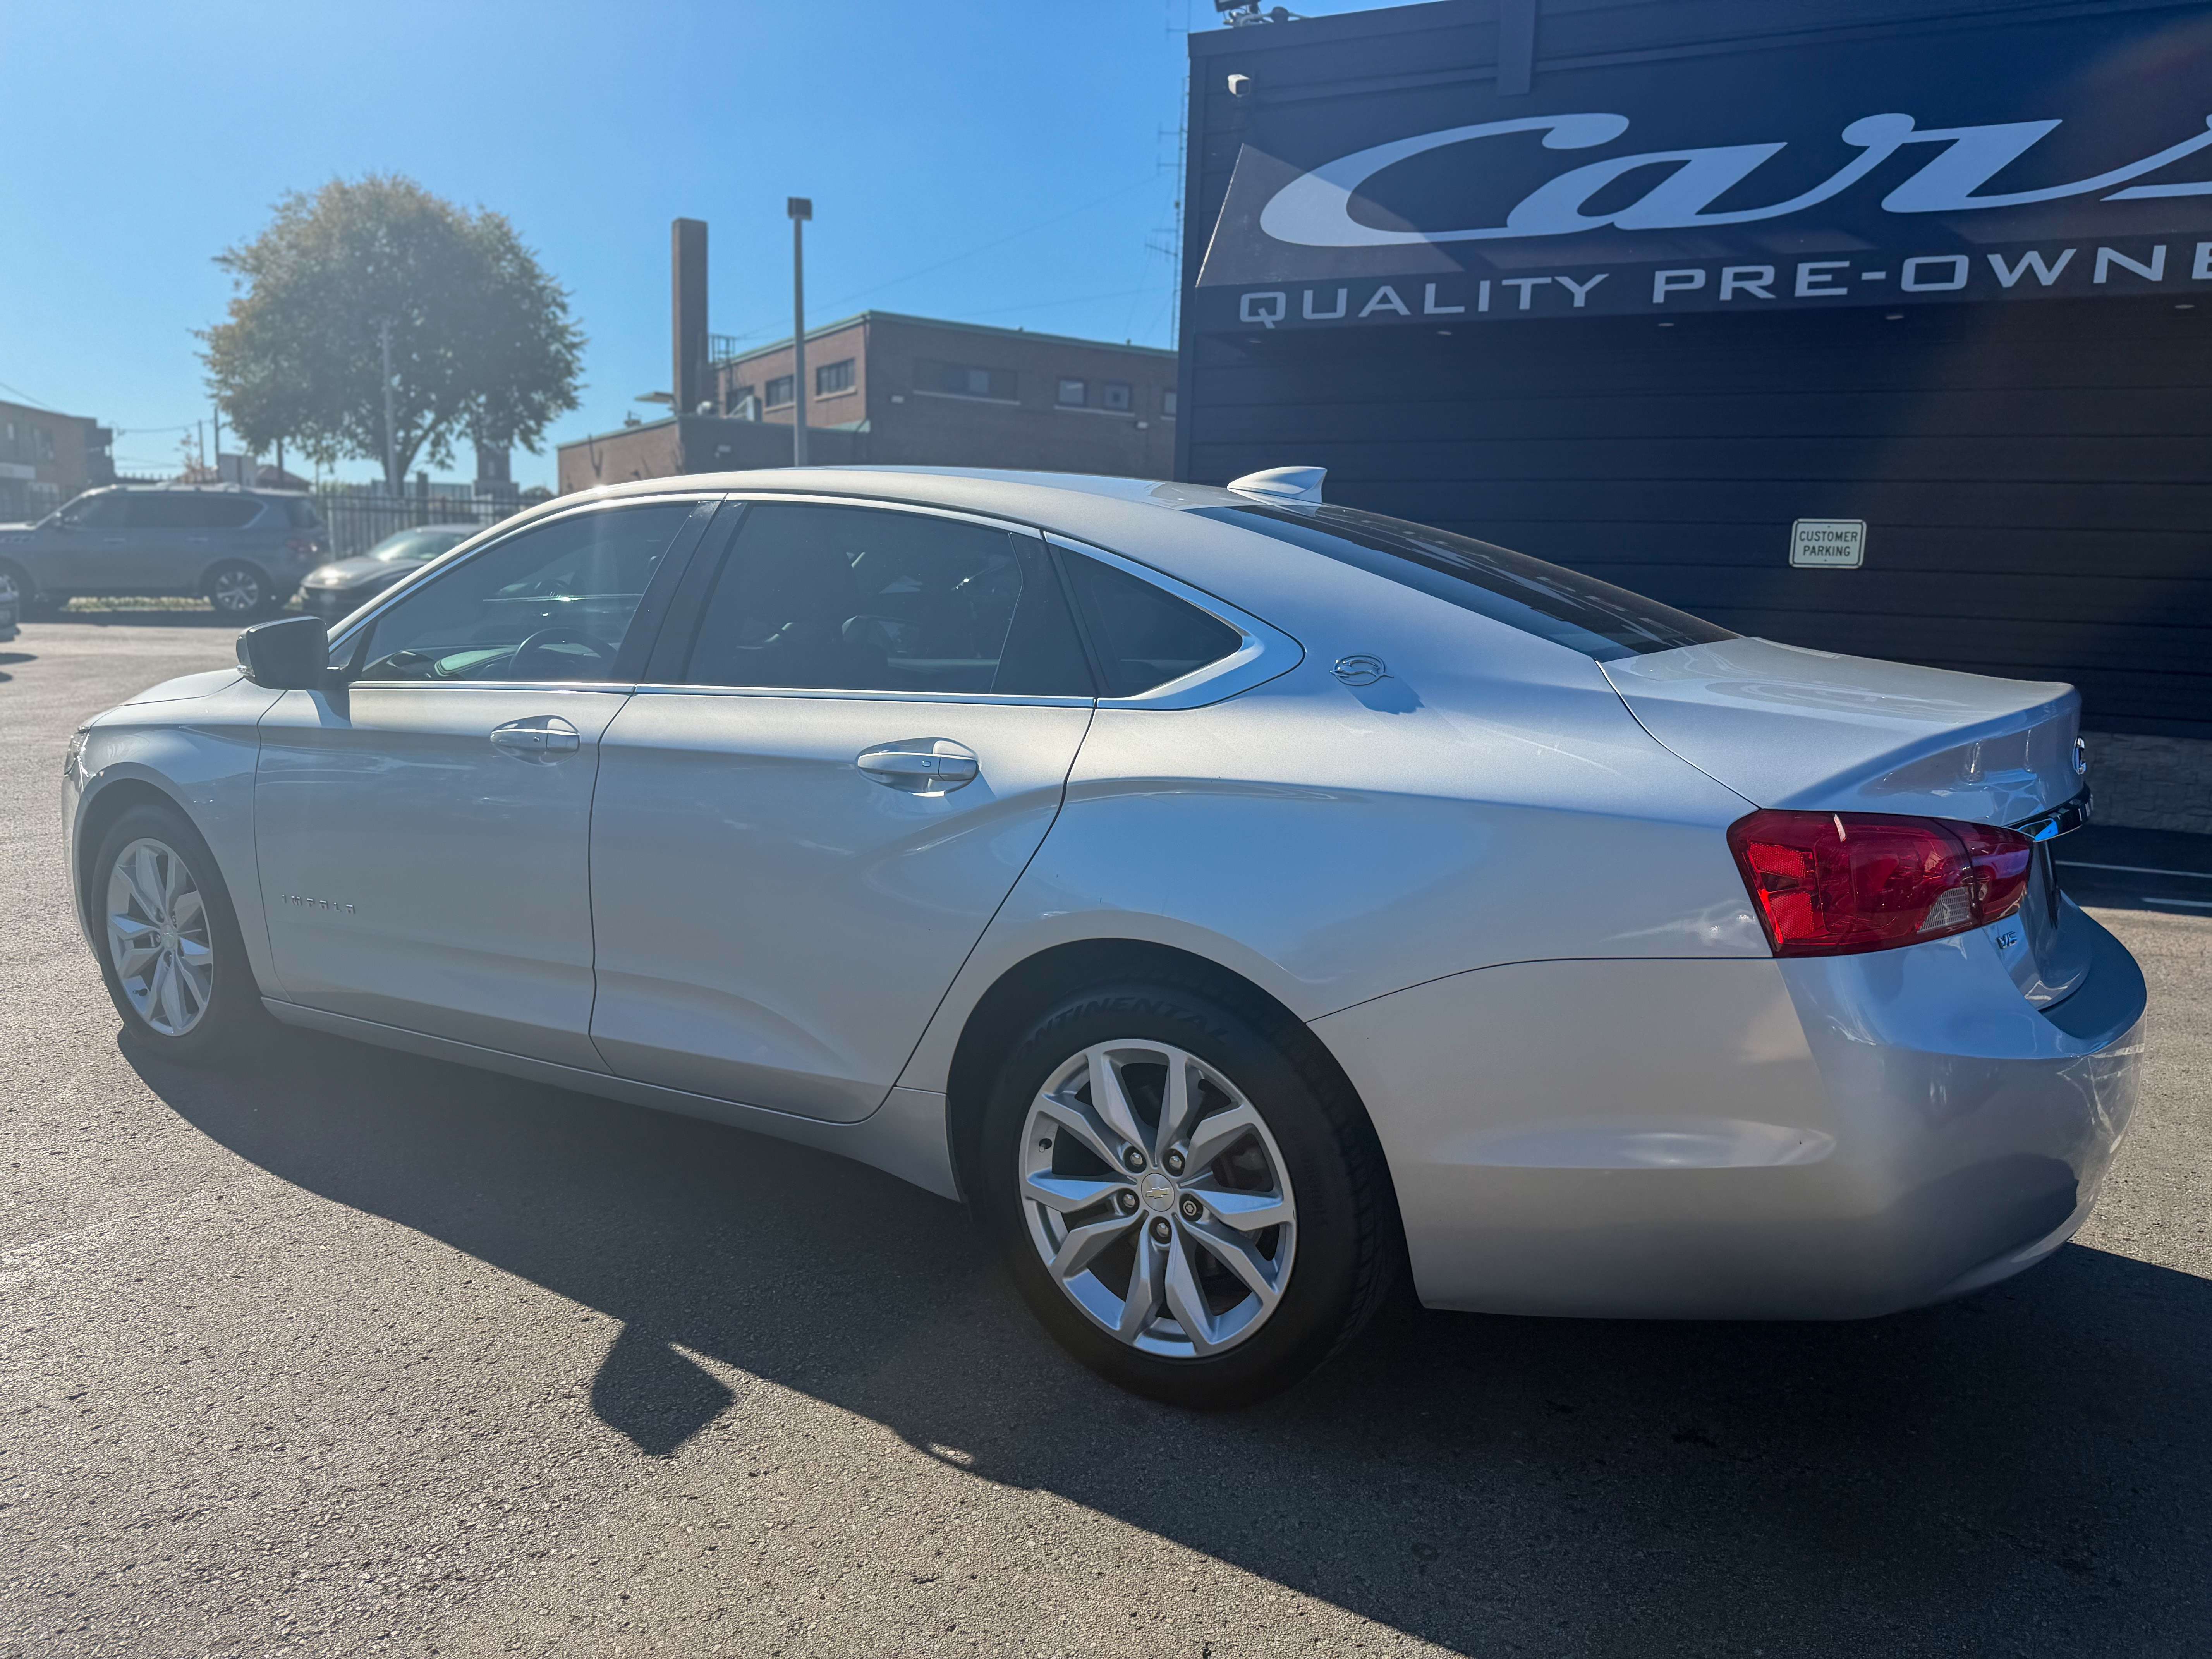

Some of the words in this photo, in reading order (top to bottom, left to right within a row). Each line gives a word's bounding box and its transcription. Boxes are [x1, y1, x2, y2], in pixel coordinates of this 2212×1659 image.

[1259, 113, 2212, 247] Car
[1240, 273, 1609, 329] QUALITY
[1799, 531, 1858, 542] CUSTOMER
[1803, 545, 1851, 556] PARKING
